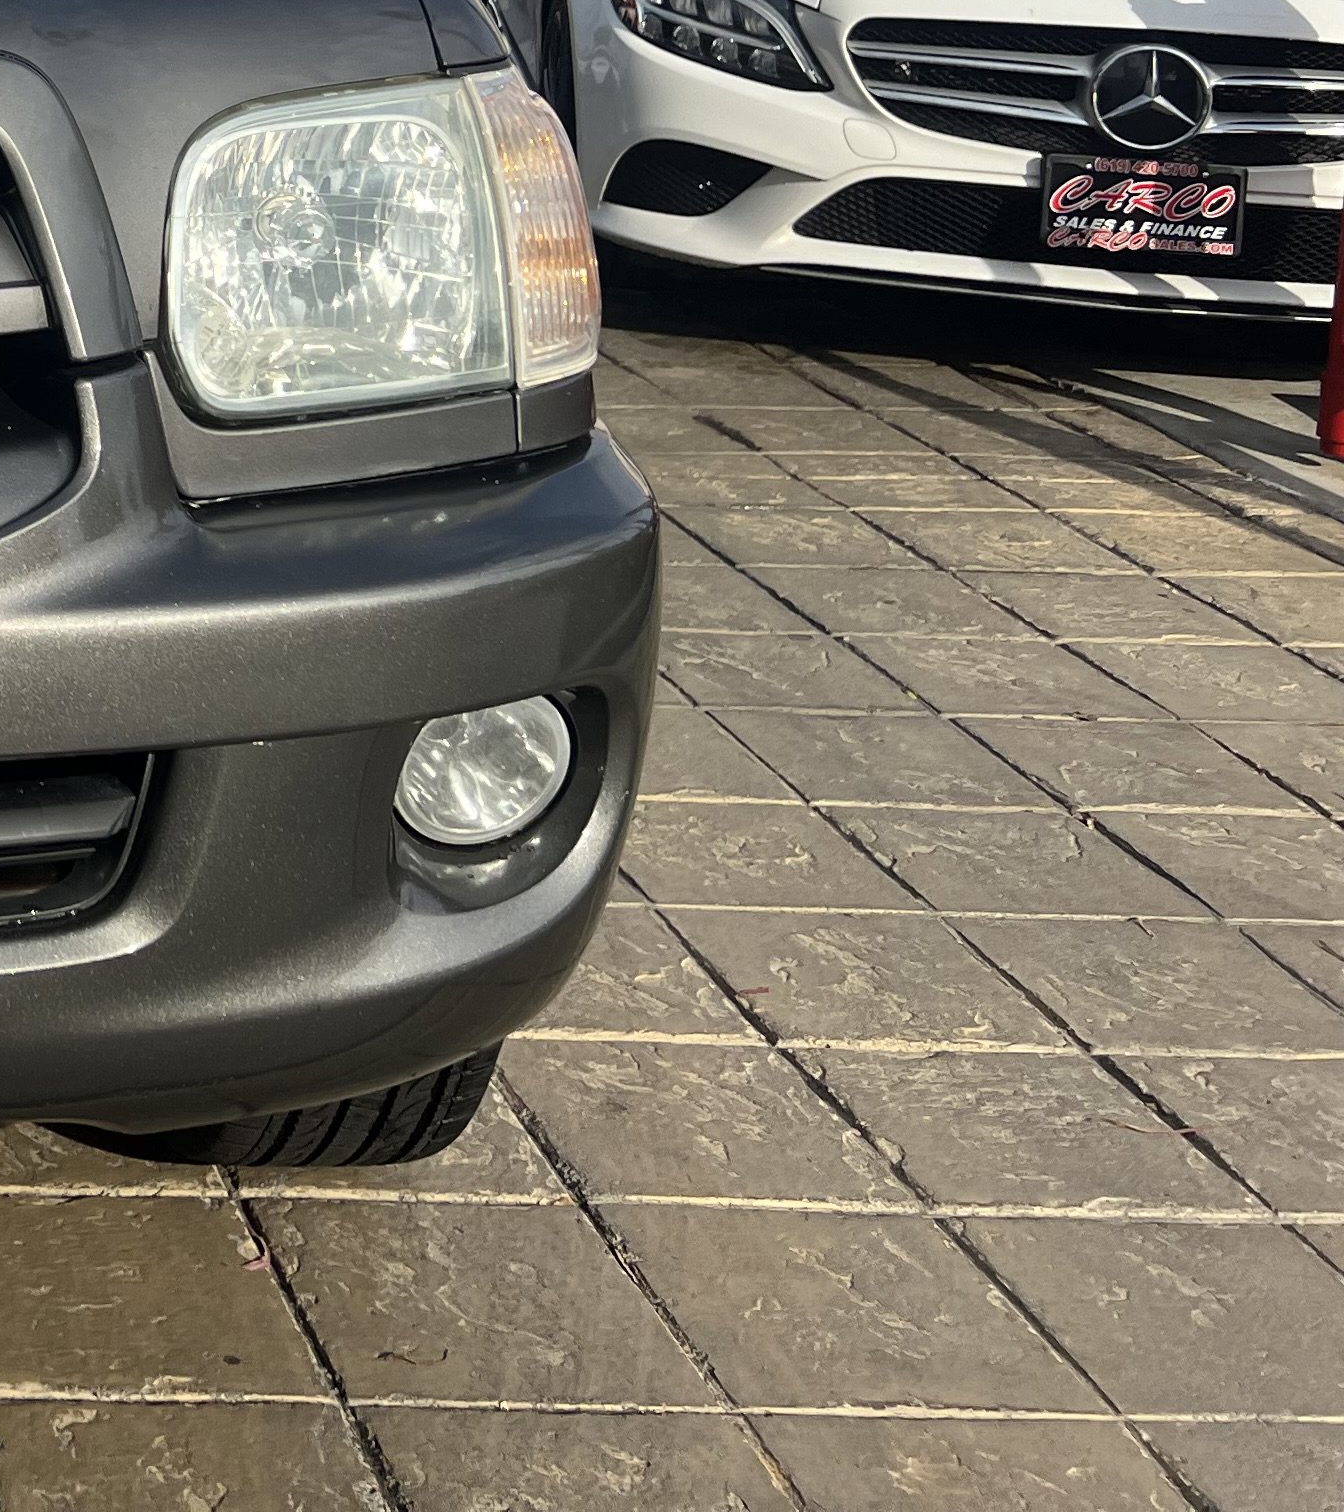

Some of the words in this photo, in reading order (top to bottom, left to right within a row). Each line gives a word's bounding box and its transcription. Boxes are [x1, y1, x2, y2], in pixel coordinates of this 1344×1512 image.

[1049, 175, 1236, 222] CARCO
[1047, 225, 1148, 251] CARCO
[1149, 239, 1234, 255] SALES.COM
[1053, 215, 1115, 231] SALES
[1120, 220, 1135, 233] &
[1140, 221, 1228, 240] FINANCE
